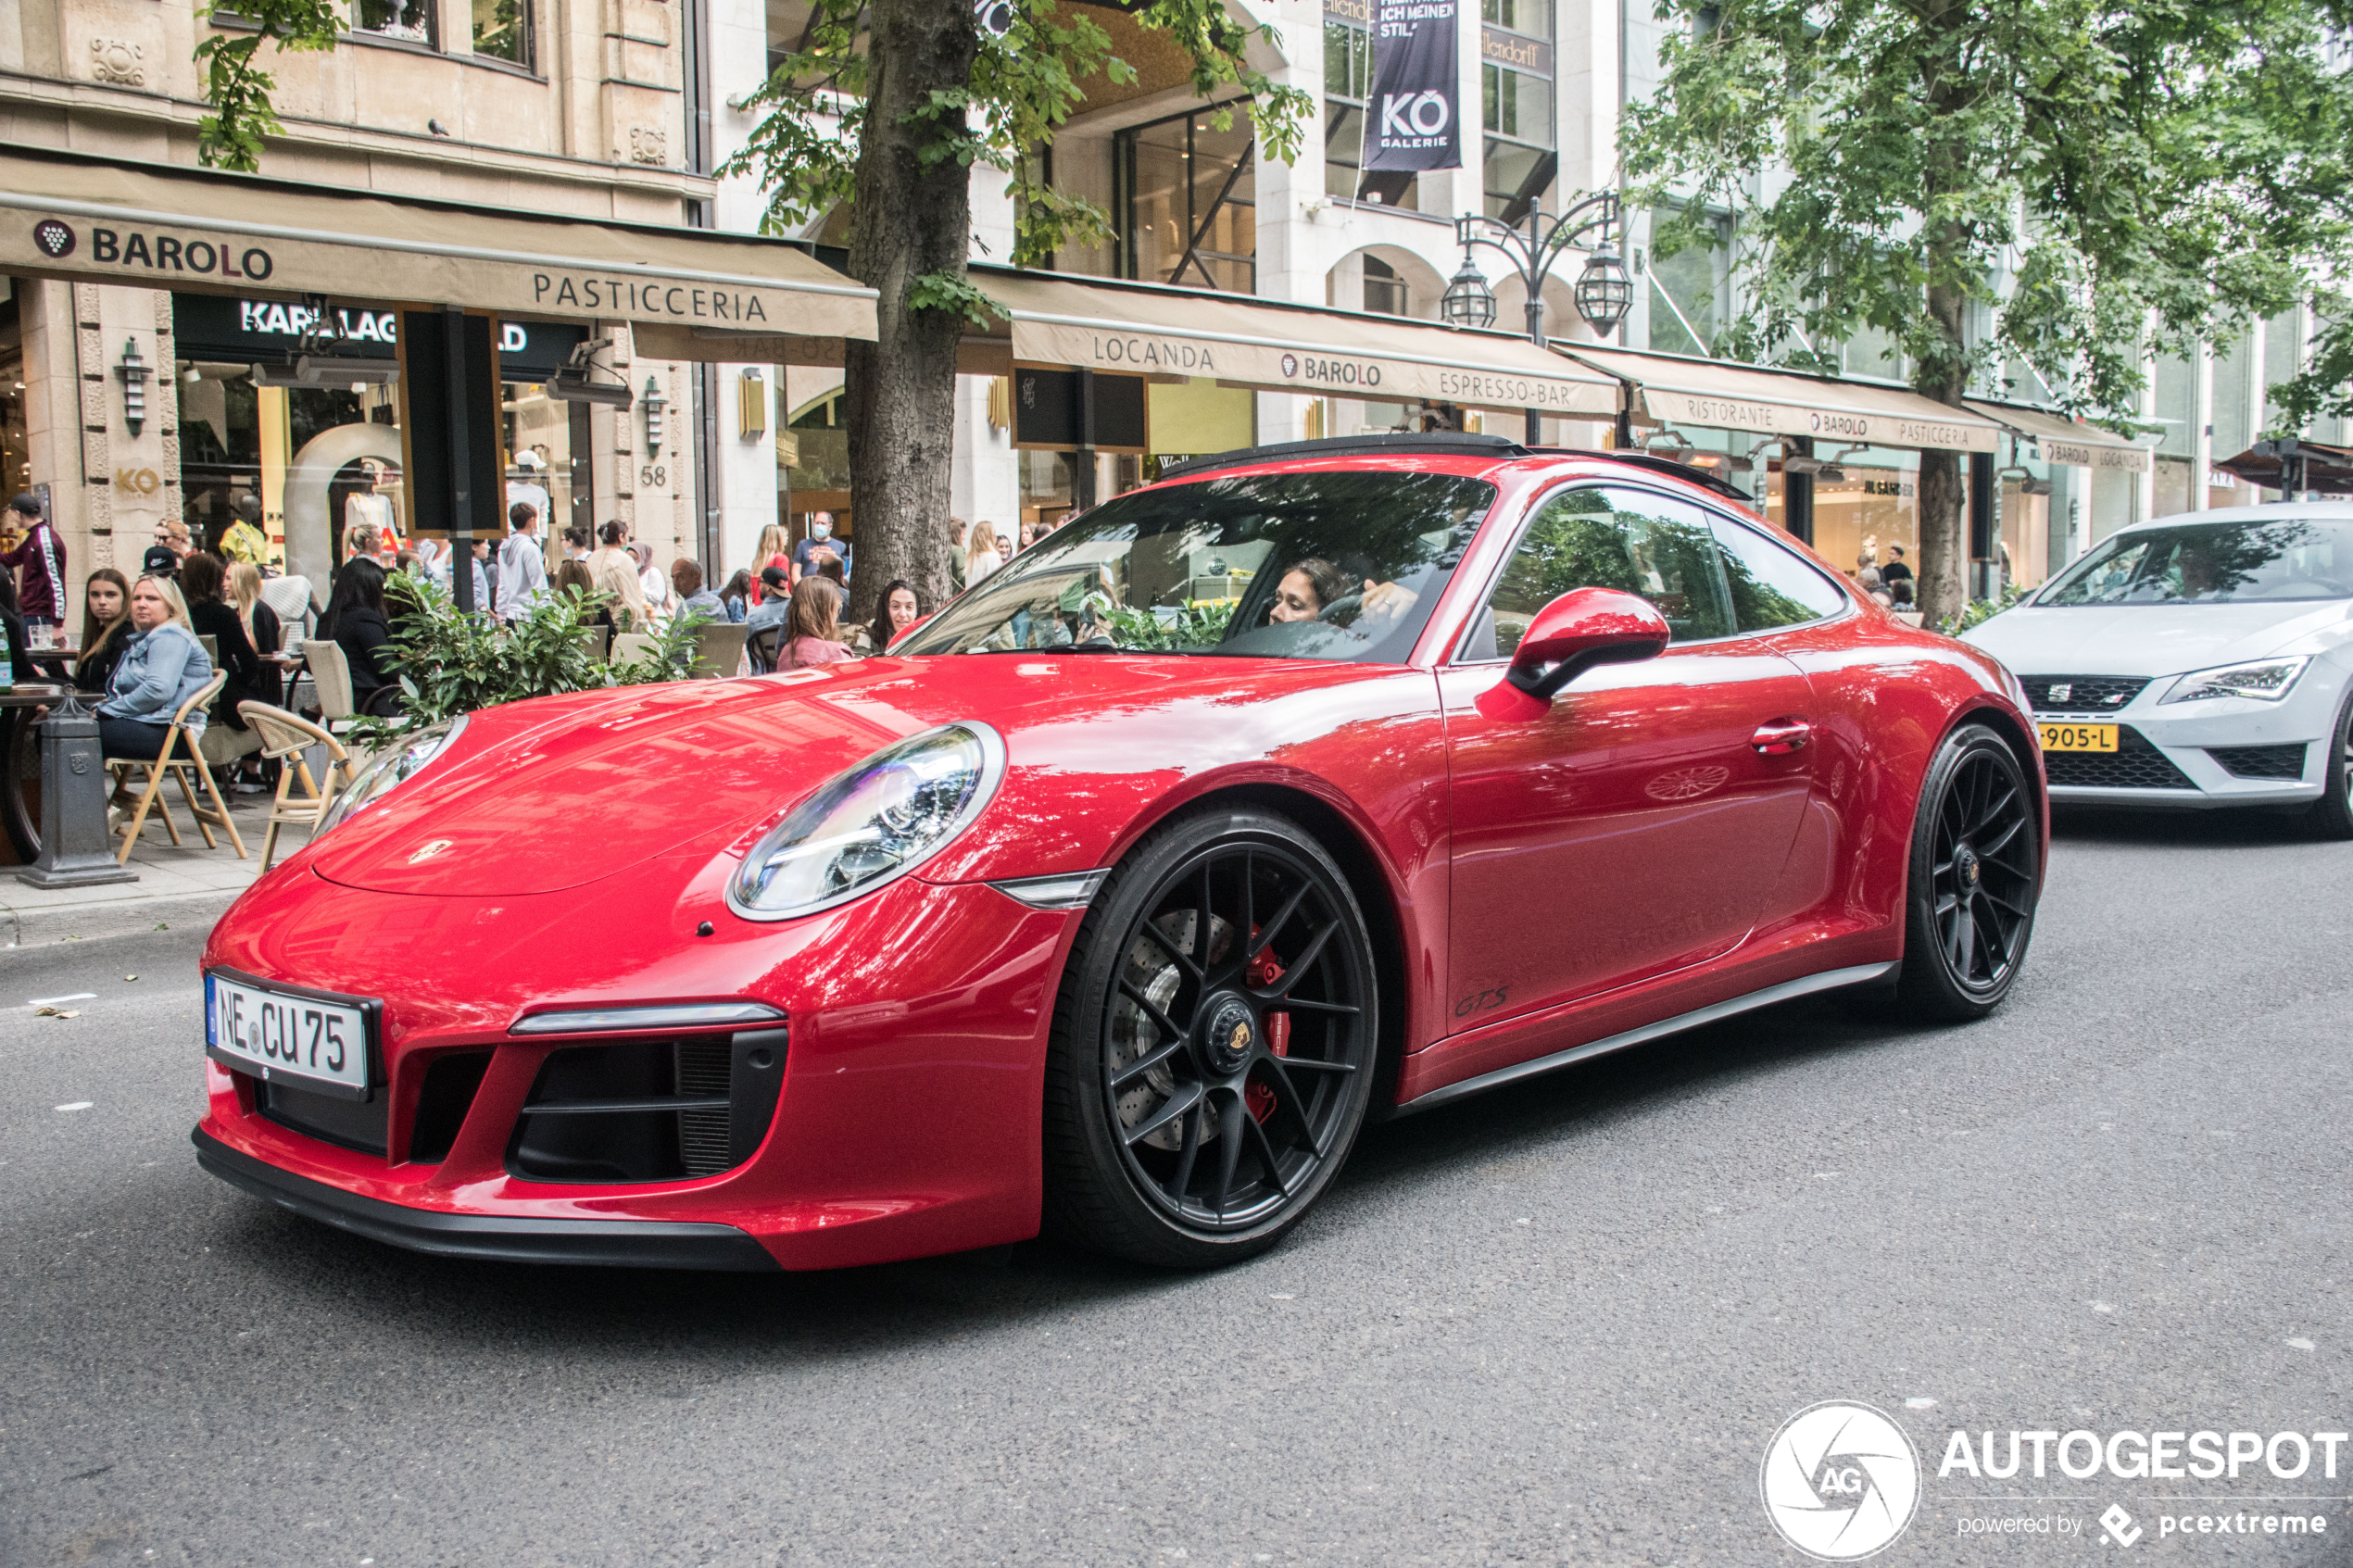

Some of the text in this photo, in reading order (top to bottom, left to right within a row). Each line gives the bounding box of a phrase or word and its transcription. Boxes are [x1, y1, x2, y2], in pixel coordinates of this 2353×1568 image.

[1380, 3, 1454, 22] ICH MEINEN
[1482, 31, 1539, 68] llendorff
[1380, 136, 1448, 148] GALERIE
[93, 228, 273, 281] BAROLO
[534, 273, 767, 322] PASTICCERIA
[1094, 336, 1214, 371] LOCANDA
[1304, 358, 1381, 387] BAROLO
[1440, 372, 1570, 406] ESPRESSO-BAR
[1688, 399, 1772, 426] RISTORANTE
[1824, 415, 1868, 436] BAROLO
[1899, 423, 1969, 446] PASTICCERIA
[2056, 445, 2090, 464] BAROLO
[2099, 450, 2142, 469] LOCANDA
[641, 465, 666, 487] 58
[1454, 985, 1510, 1018] GTS
[220, 987, 248, 1049] NE
[262, 1001, 300, 1065] CU
[306, 1009, 346, 1073] 75
